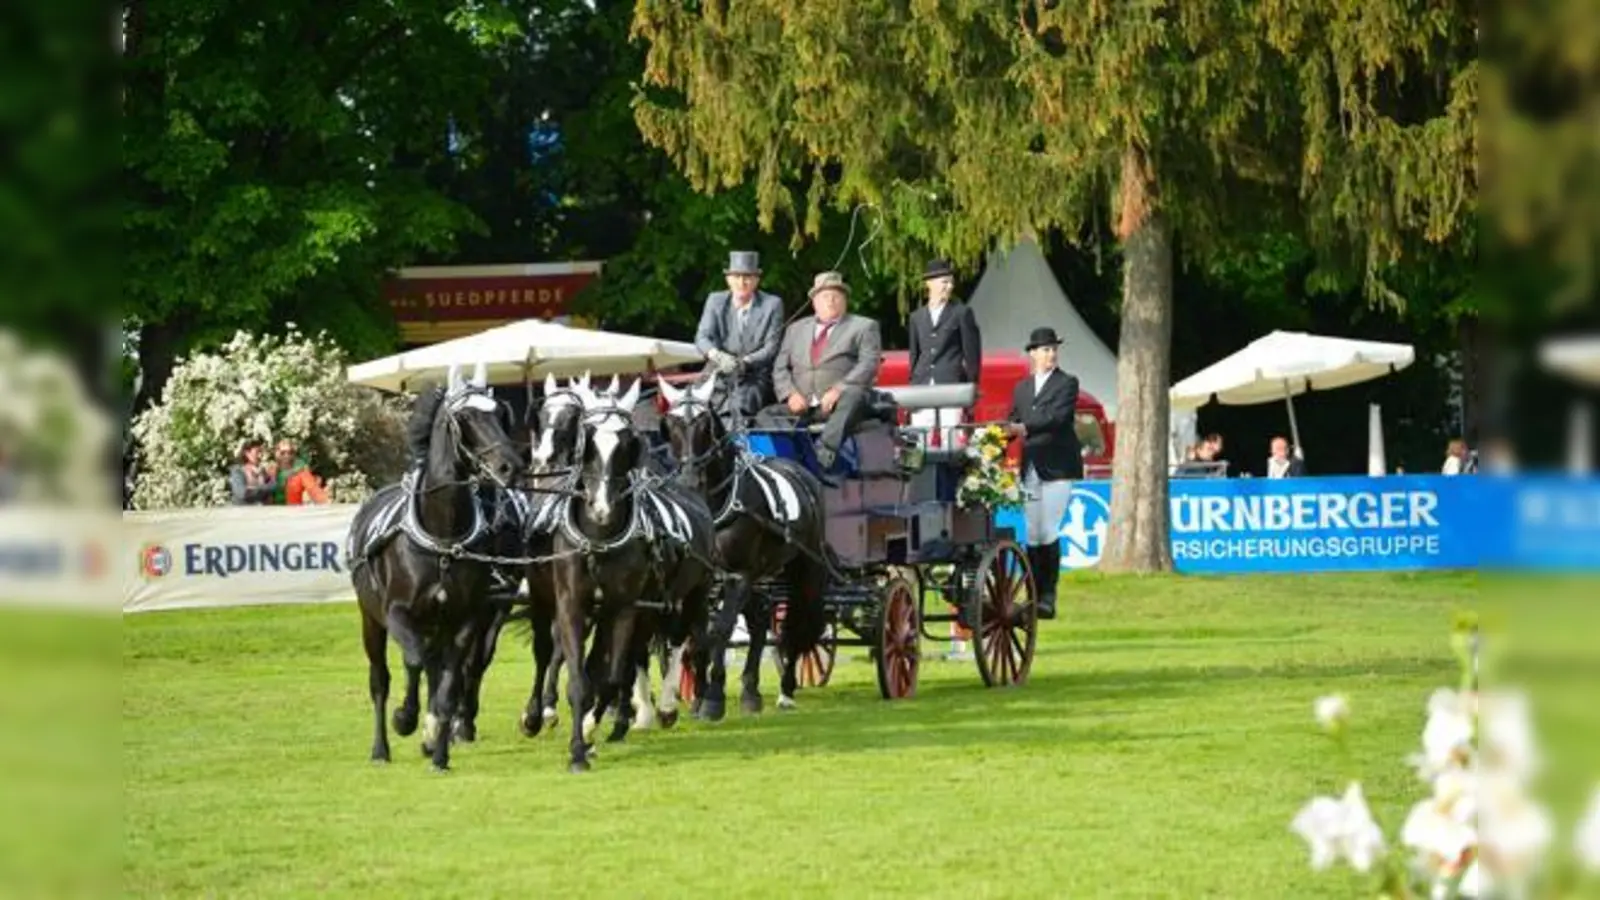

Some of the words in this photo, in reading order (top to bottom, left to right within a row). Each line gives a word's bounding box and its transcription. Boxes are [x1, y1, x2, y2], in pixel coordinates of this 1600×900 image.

[1171, 491, 1440, 532] ÜRNBERGER
[185, 542, 342, 576] ERDINGER
[1172, 534, 1440, 559] RSICHERUNGSGRUPPE
